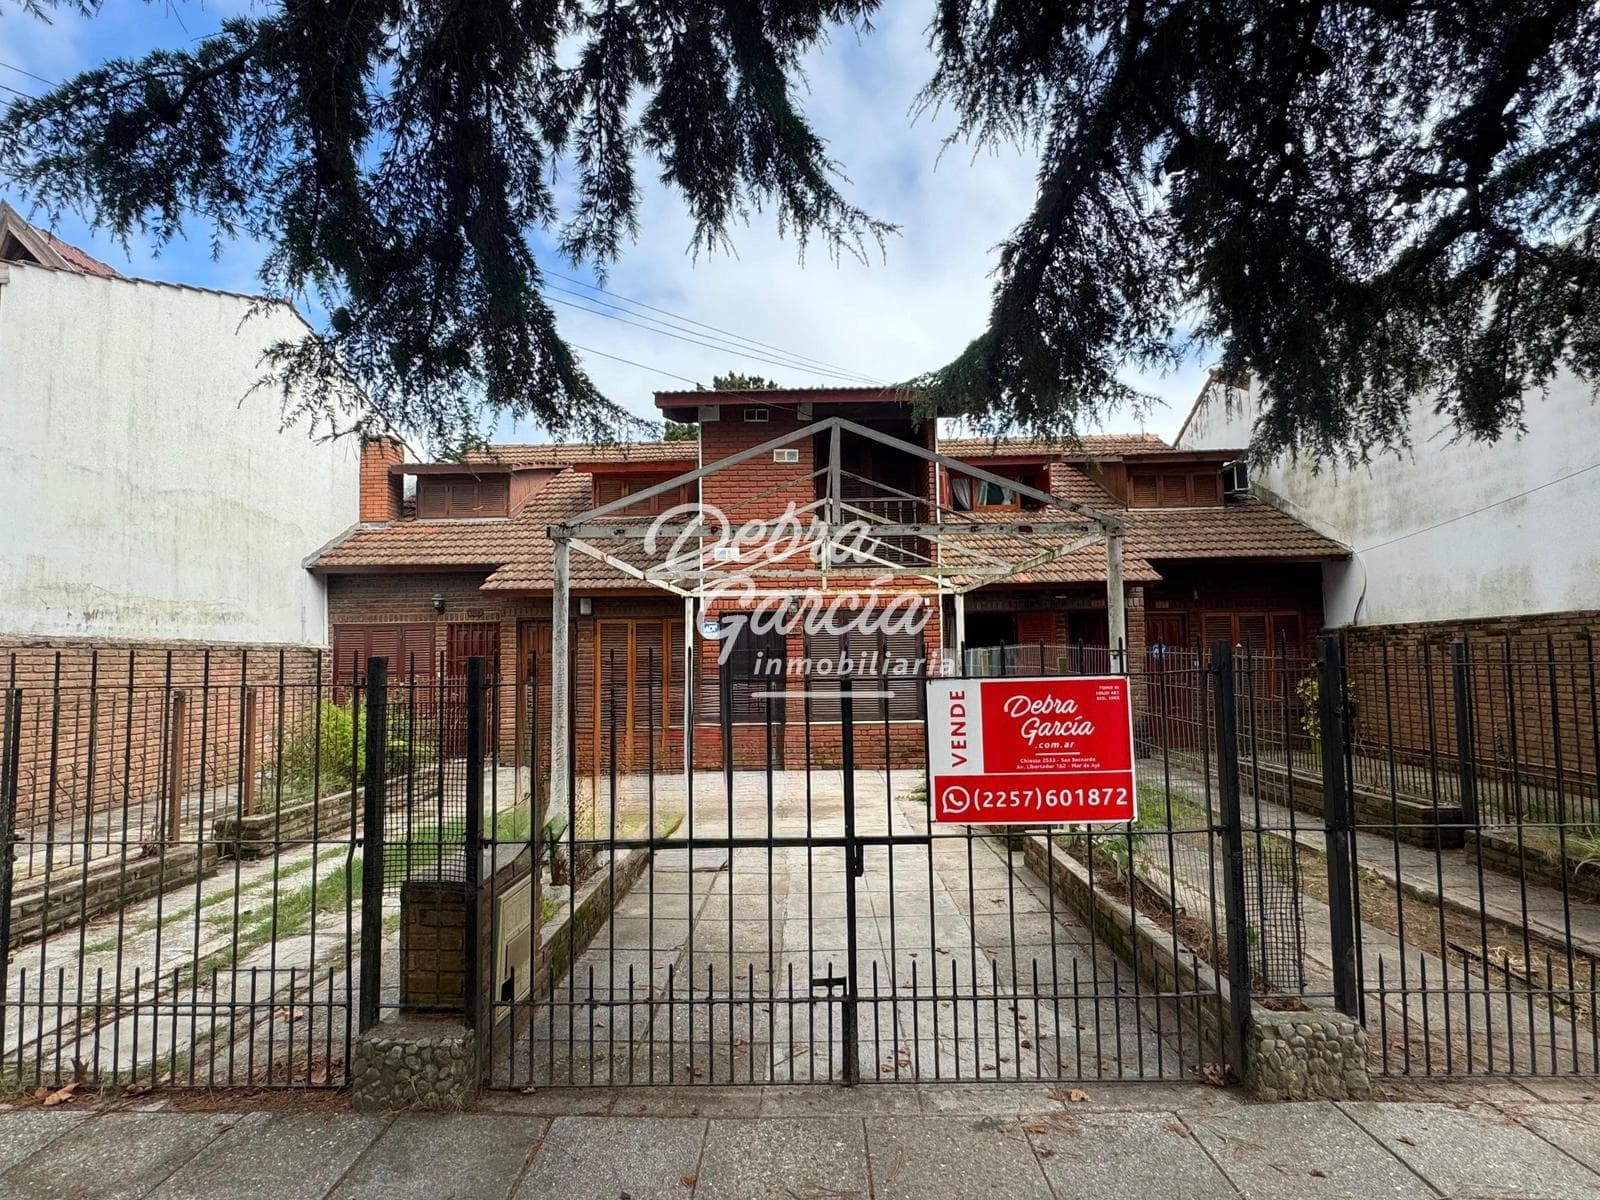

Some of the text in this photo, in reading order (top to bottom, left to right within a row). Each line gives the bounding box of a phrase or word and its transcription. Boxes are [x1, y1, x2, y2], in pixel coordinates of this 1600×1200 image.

[1004, 694, 1078, 718] Debra
[950, 690, 968, 768] VENDE
[1021, 716, 1095, 746] García
[1035, 741, 1075, 749] .com.ar
[974, 788, 1128, 811] (2257)601872
